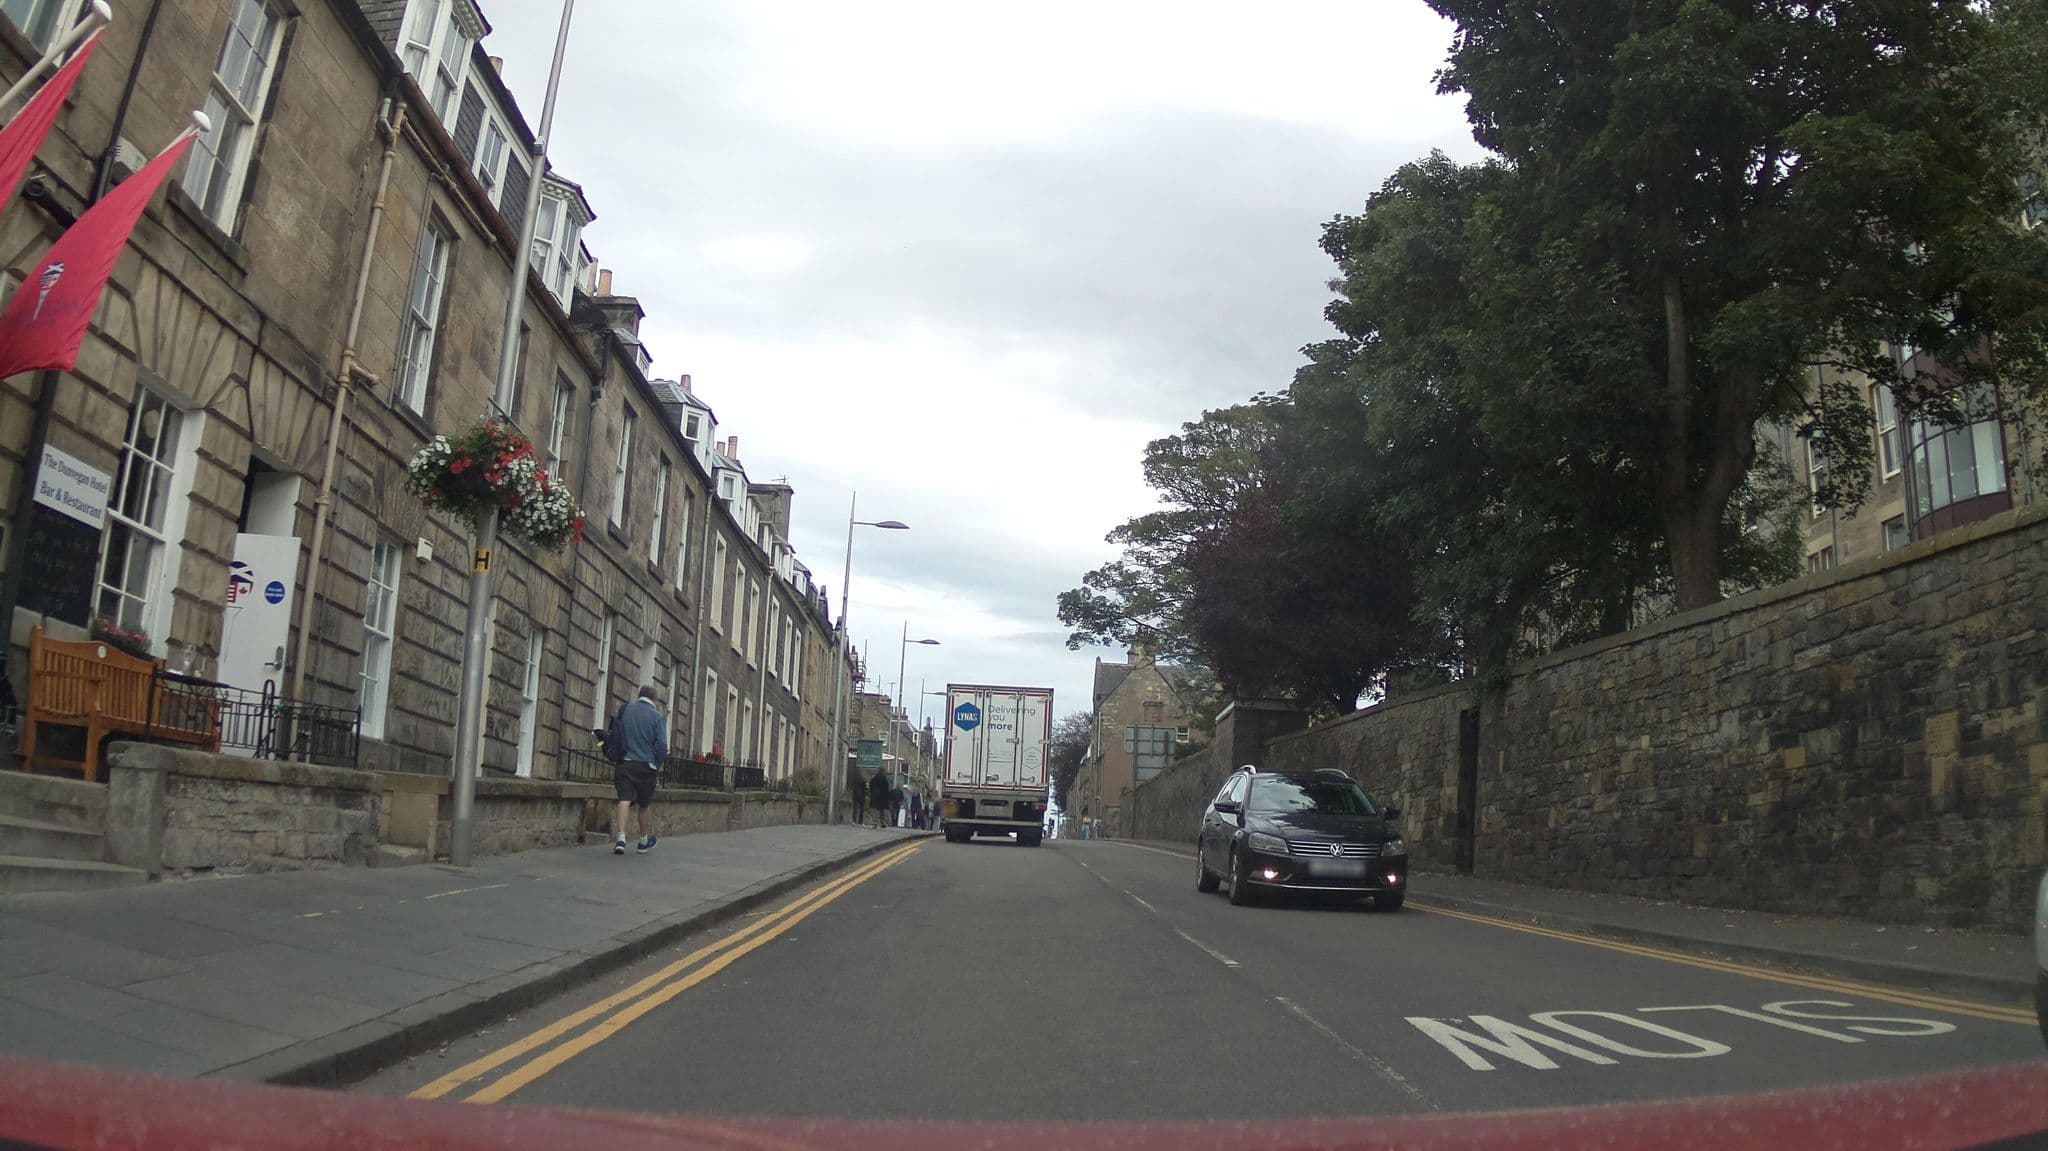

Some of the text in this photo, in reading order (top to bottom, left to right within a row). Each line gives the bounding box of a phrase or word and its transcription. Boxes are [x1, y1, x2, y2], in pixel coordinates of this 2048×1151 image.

[44, 453, 107, 495] The Dunvegan Hotel
[40, 481, 102, 520] Bar & Restaurant
[475, 550, 490, 570] H
[987, 722, 1013, 731] more
[988, 714, 1005, 723] you
[1404, 1000, 1957, 1071] SLOW
